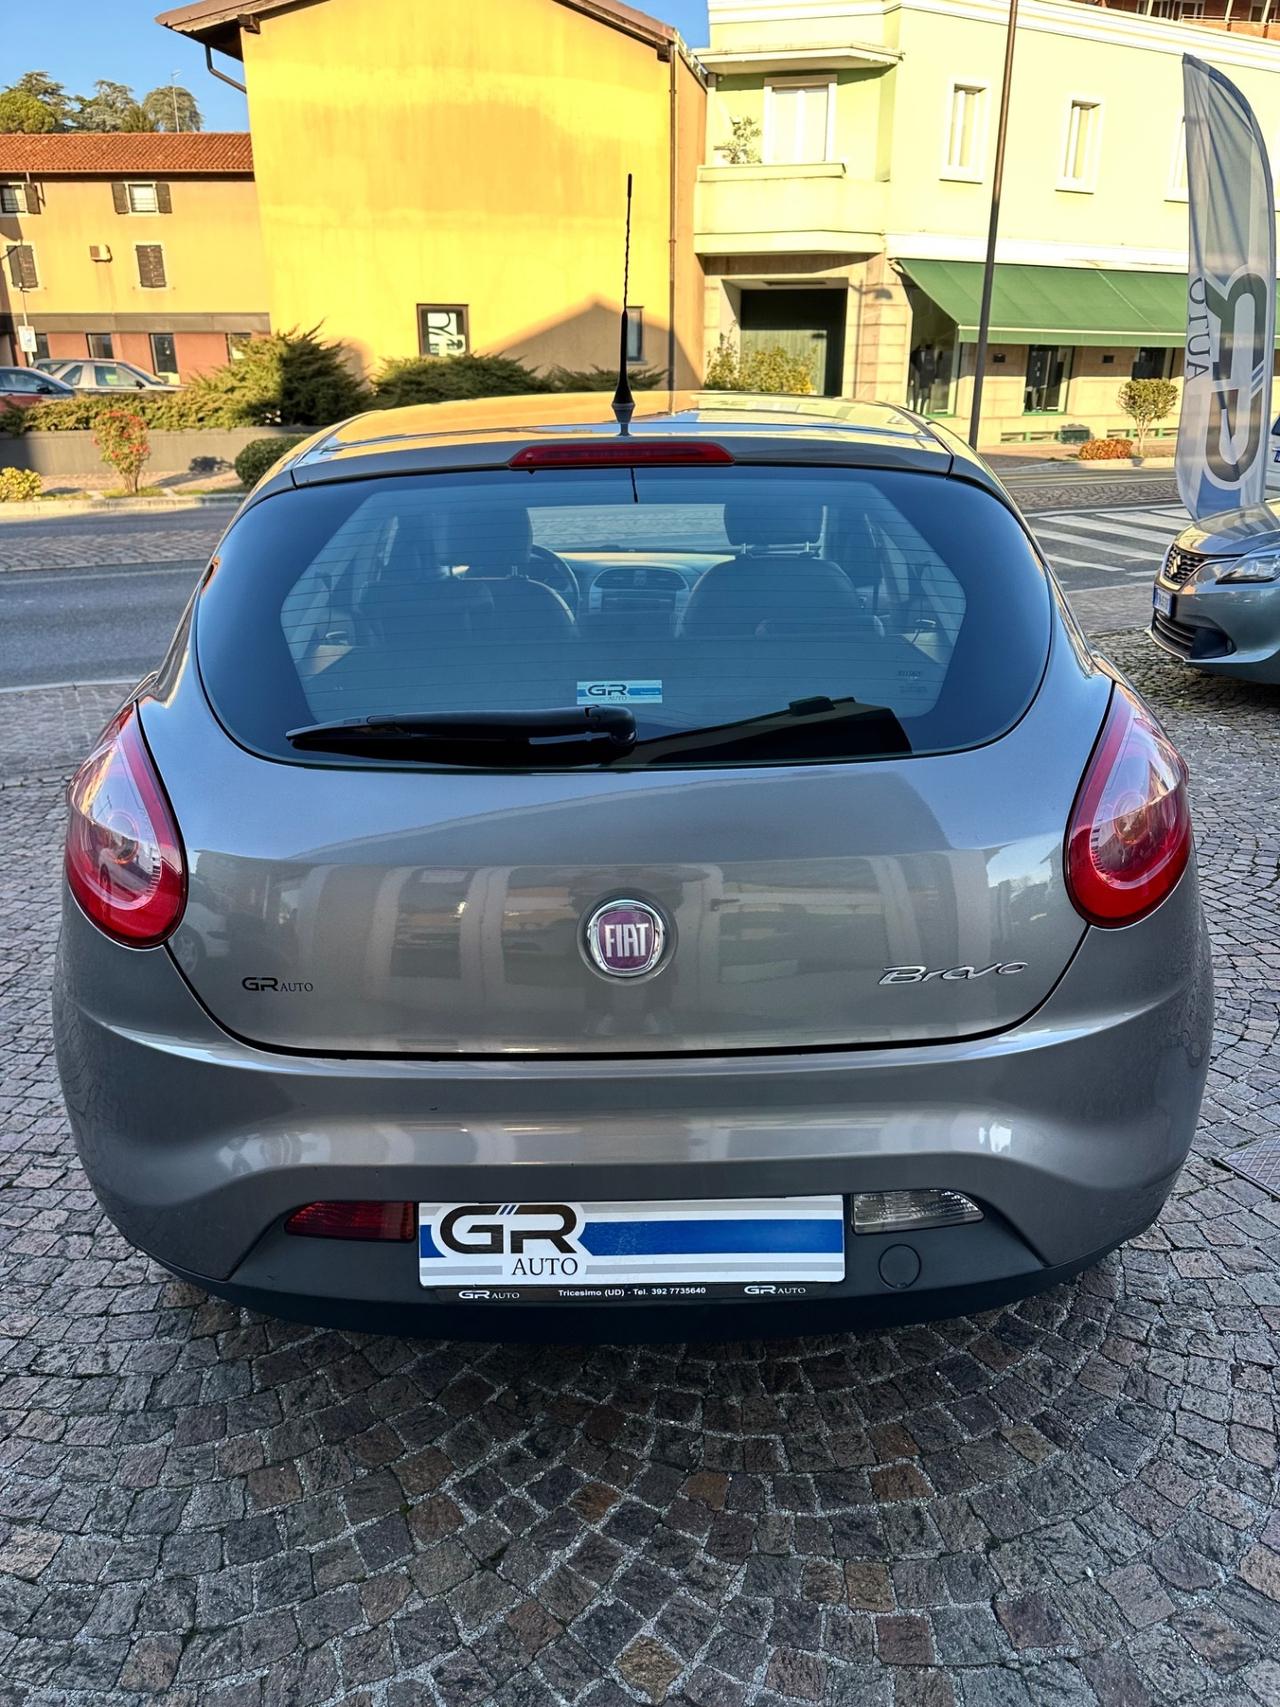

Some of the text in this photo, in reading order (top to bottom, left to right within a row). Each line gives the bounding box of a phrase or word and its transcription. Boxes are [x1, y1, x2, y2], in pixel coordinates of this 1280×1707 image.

[588, 684, 627, 696] GR
[604, 923, 649, 958] FIAT
[878, 961, 1029, 986] Bravo
[242, 976, 314, 992] GR AUTO
[440, 1204, 578, 1254] GR
[511, 1257, 579, 1276] AUTO
[458, 1290, 490, 1299] GR
[558, 1289, 602, 1297] Tricesimo
[604, 1288, 625, 1297] (UD)
[651, 1287, 668, 1295] 392
[670, 1287, 706, 1295] 7735640
[743, 1285, 776, 1294] GR
